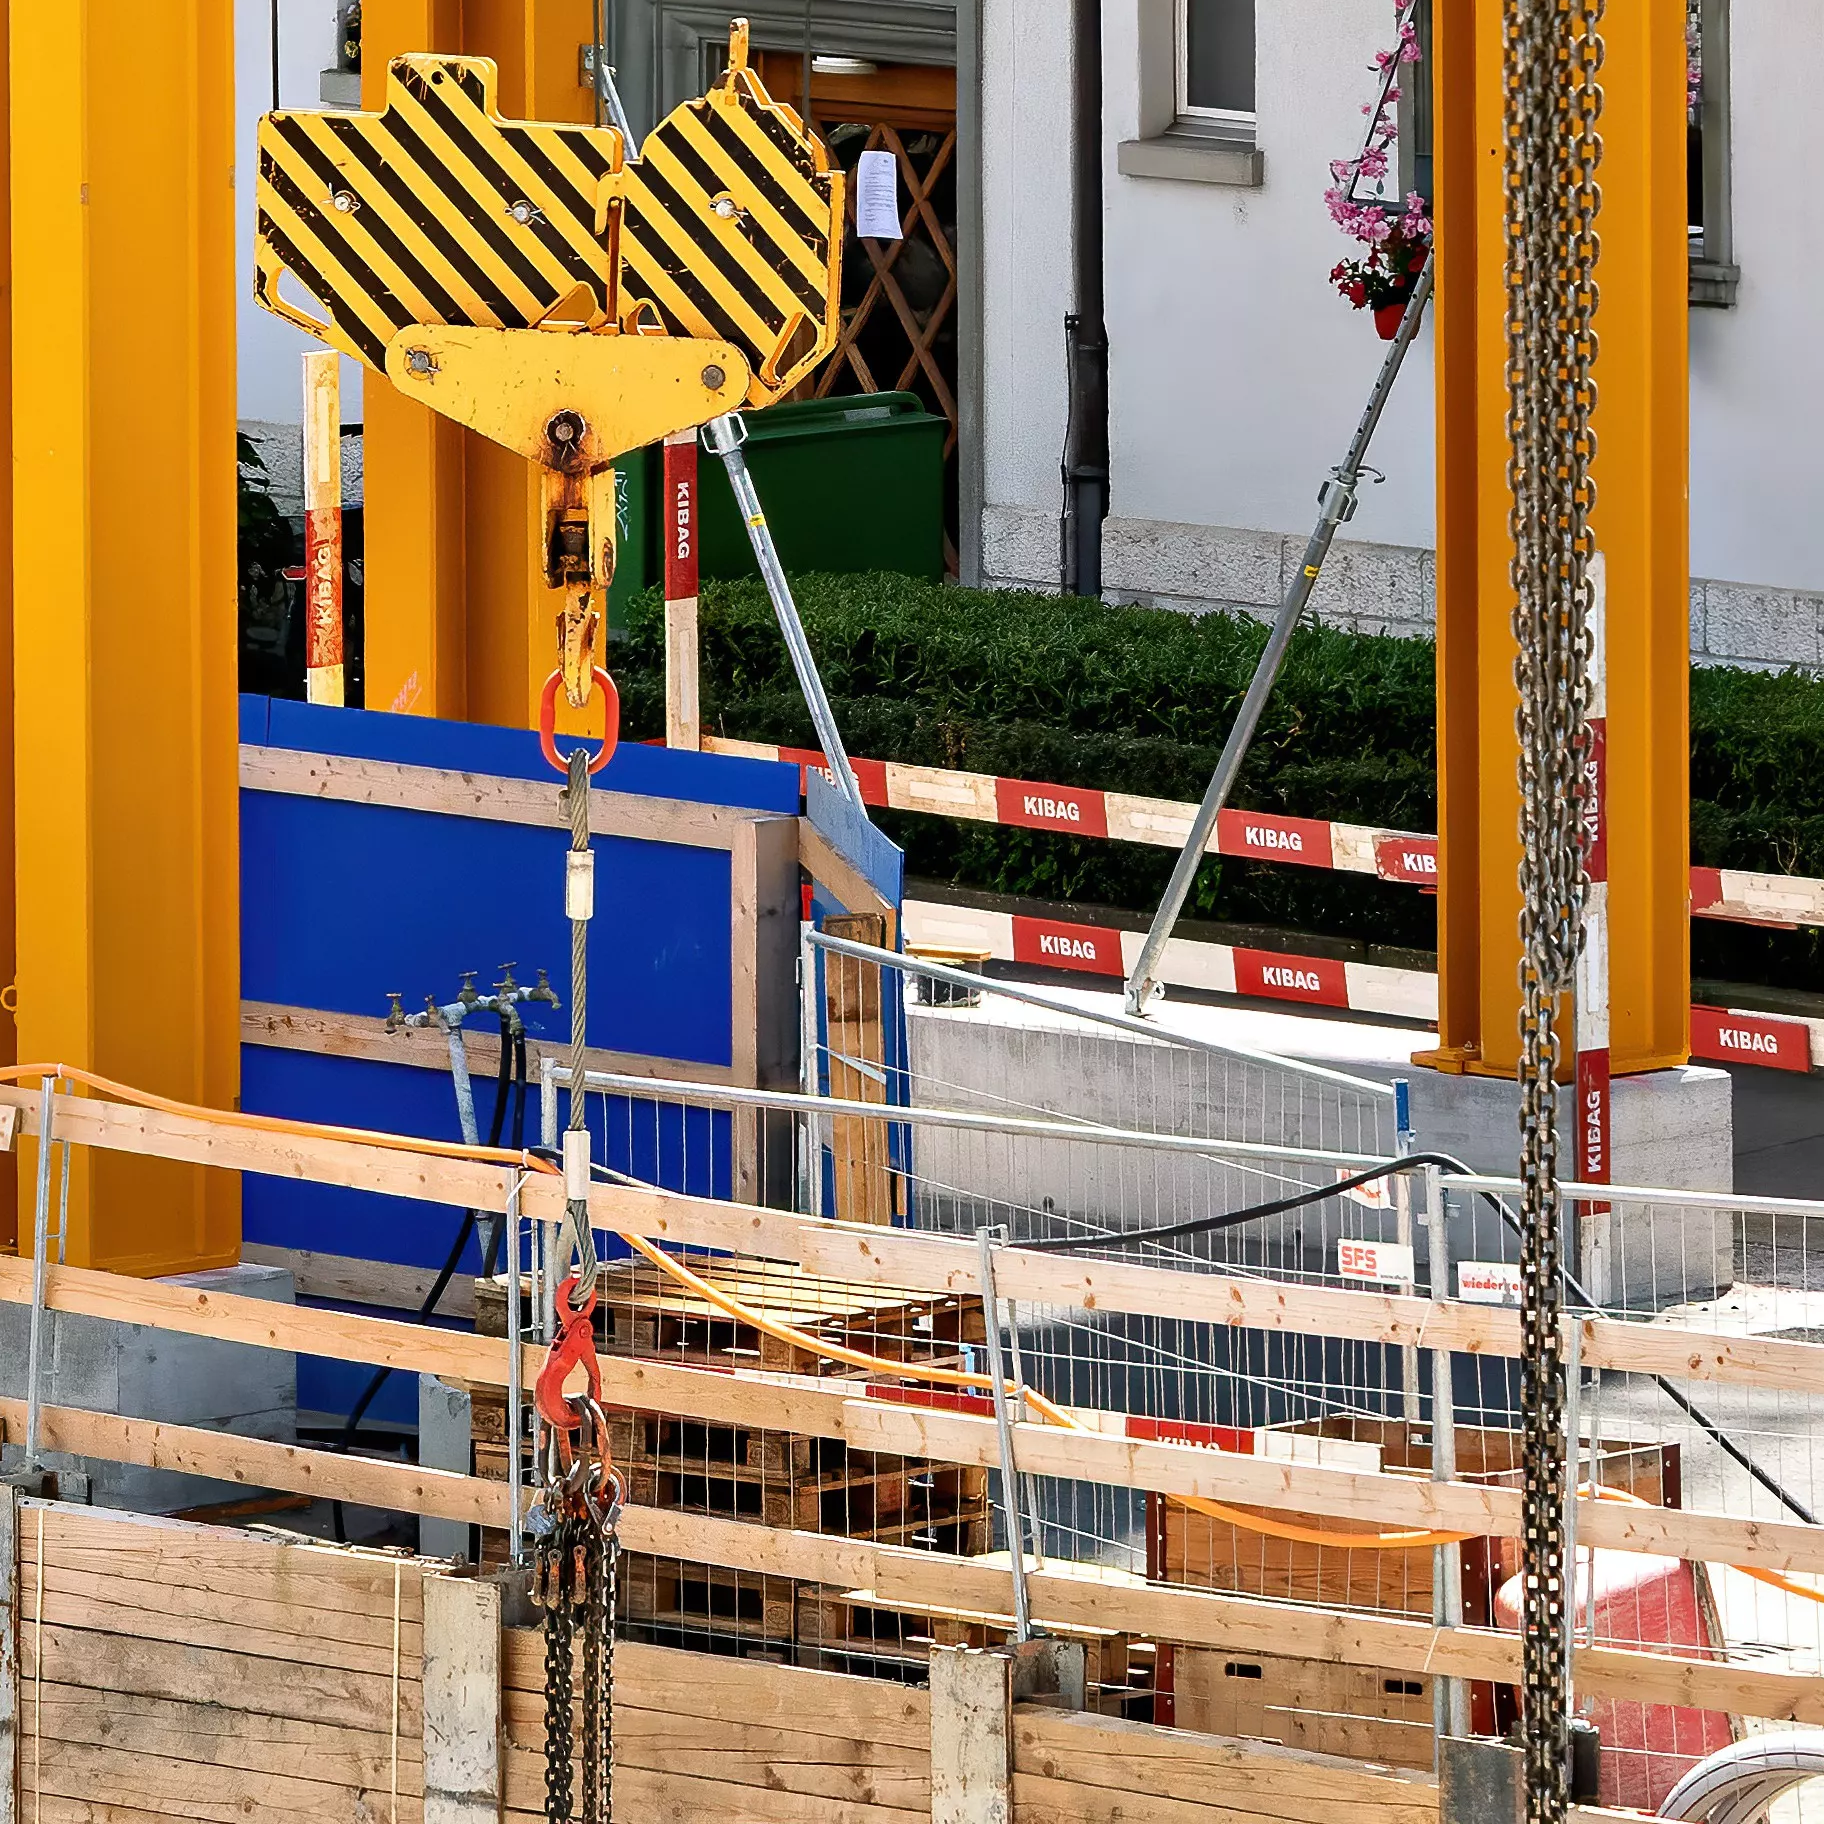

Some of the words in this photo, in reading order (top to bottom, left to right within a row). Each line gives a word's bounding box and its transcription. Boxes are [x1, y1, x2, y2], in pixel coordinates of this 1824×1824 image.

[678, 482, 690, 559] KIBAG
[1024, 796, 1080, 821] KIBAG
[1245, 826, 1303, 852] KIBAG
[1402, 852, 1438, 873] KIB
[1040, 934, 1096, 960] KIBAG
[1262, 966, 1320, 991] KIBAG
[1718, 1028, 1778, 1054] KIBAG
[1587, 1090, 1601, 1173] KIBAG
[1341, 1245, 1378, 1270] SFS
